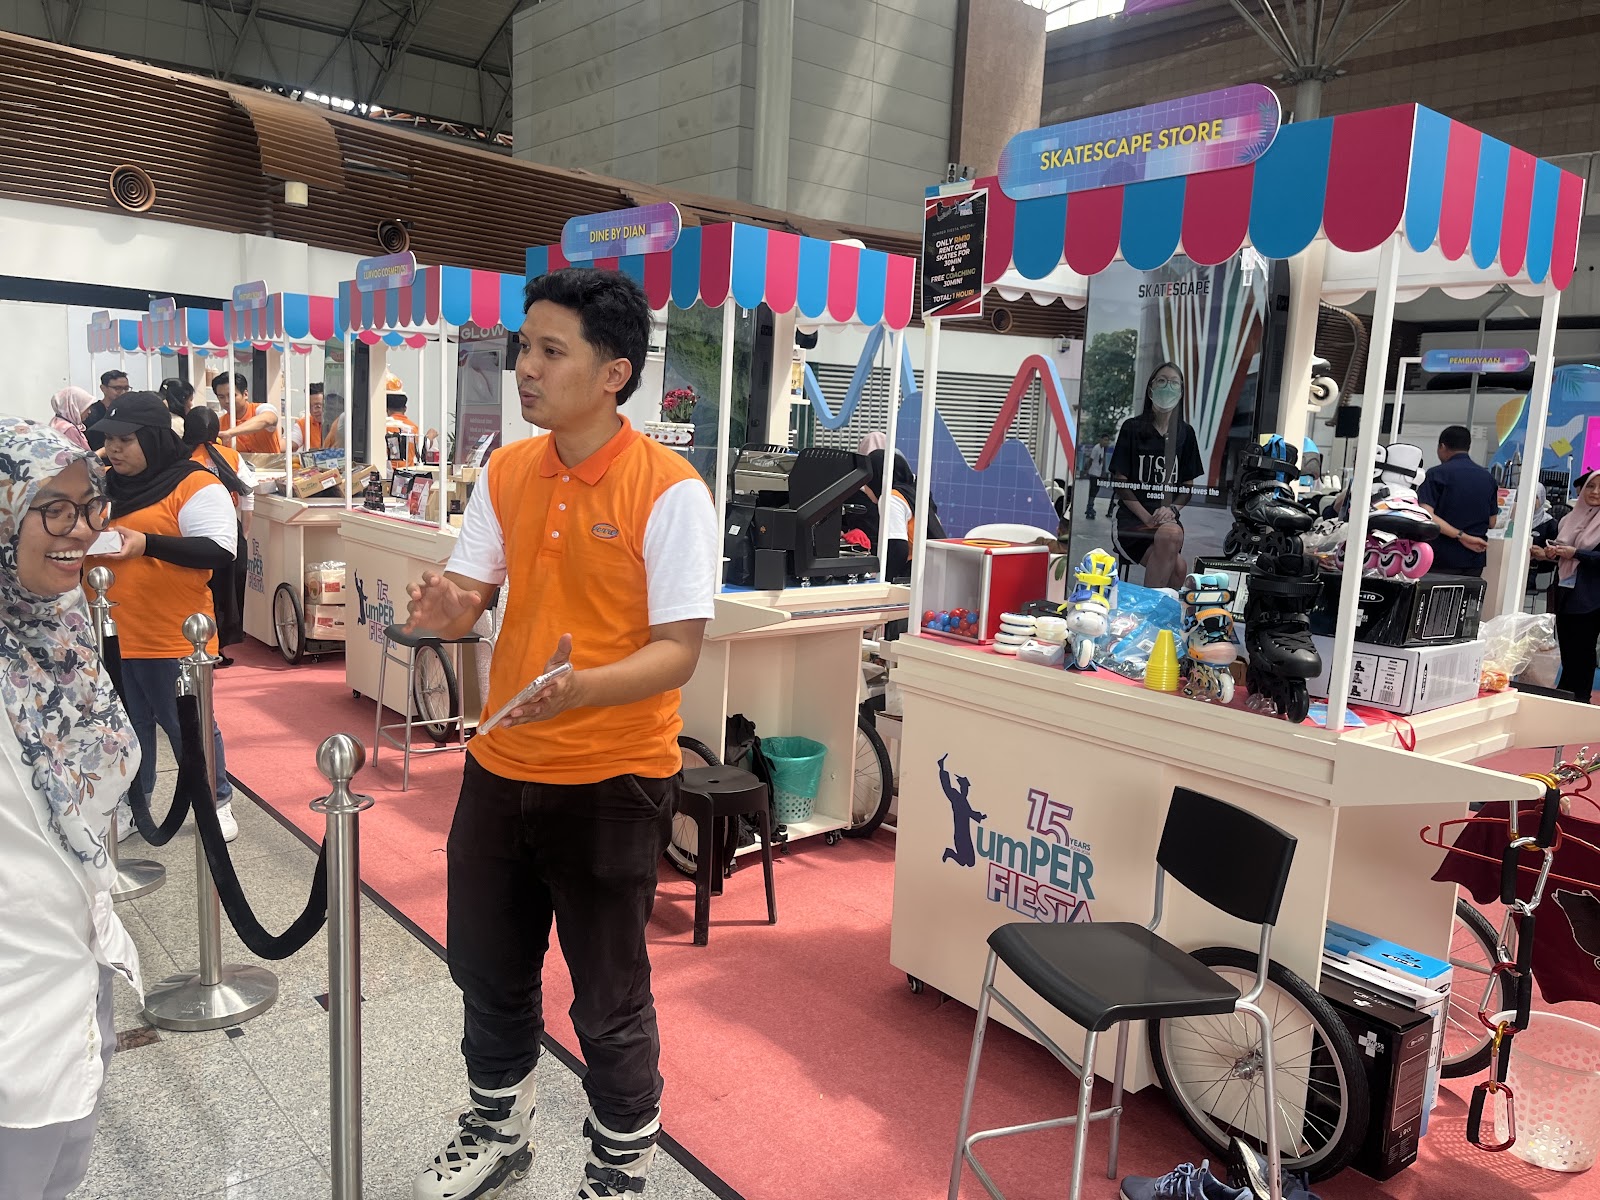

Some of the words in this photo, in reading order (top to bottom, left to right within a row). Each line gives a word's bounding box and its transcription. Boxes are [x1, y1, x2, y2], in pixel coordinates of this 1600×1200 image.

[1039, 132, 1153, 171] SKATESCAPE
[1157, 119, 1223, 150] STORE
[589, 229, 610, 243] DINE
[611, 227, 622, 240] BY
[623, 223, 646, 239] DIAN
[936, 238, 953, 248] ONLY
[953, 234, 971, 244] RM10
[936, 251, 958, 262] SKATES
[958, 248, 970, 257] FOR
[938, 246, 954, 254] RENT
[955, 242, 968, 251] OUR
[943, 257, 962, 267] 30MIN
[930, 274, 946, 284] FREE
[945, 267, 976, 280] COACHING
[942, 278, 963, 288] 30MIN!
[932, 293, 952, 303] TOTAL:
[955, 289, 975, 299] HOUR!
[1138, 280, 1210, 298] SKATESCAPE
[460, 325, 505, 340] GLOW
[1449, 357, 1501, 365] PEMBIAYAAN
[1138, 455, 1179, 484] USA
[1096, 479, 1111, 488] keep
[1111, 481, 1141, 490] encourage
[1141, 483, 1152, 491] her
[1164, 485, 1178, 493] then
[1179, 486, 1190, 494] she
[1191, 487, 1208, 495] loves
[1208, 488, 1220, 496] the
[1146, 492, 1165, 500] coach
[377, 579, 389, 603] 15
[1027, 788, 1073, 847] 15
[1070, 837, 1091, 851] YEARS
[987, 862, 1093, 923] FIESTA
